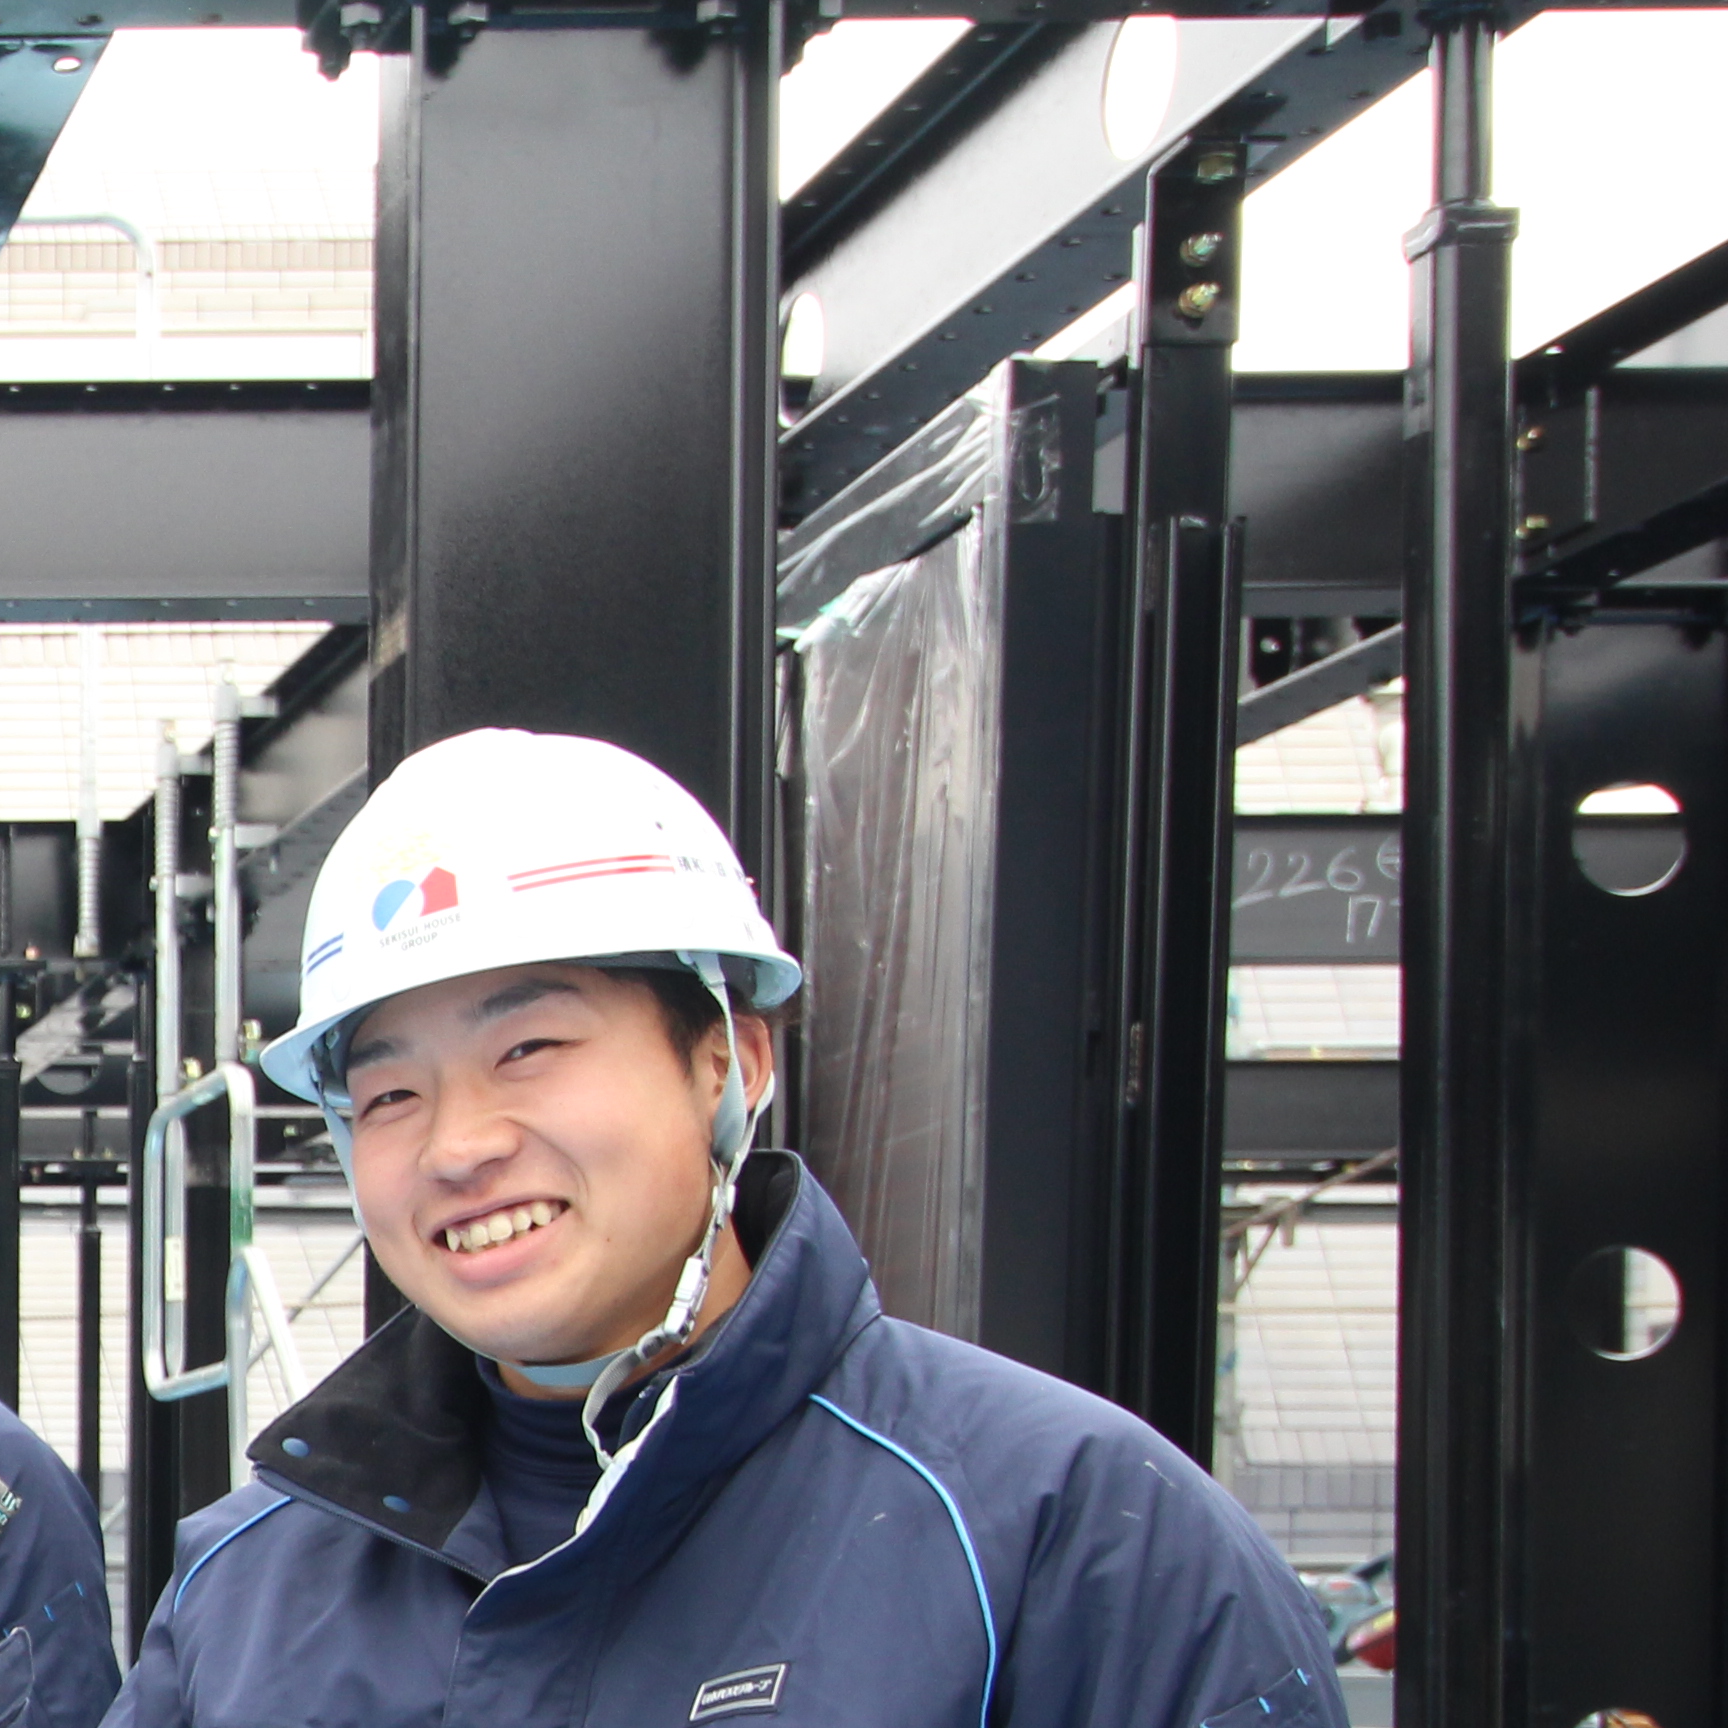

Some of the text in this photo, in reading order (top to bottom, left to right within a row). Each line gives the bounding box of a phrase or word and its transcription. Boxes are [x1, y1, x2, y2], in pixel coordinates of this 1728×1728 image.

[1231, 845, 1365, 910] 226
[379, 912, 462, 948] SEKISUI HOUSE
[401, 931, 439, 951] GROUP
